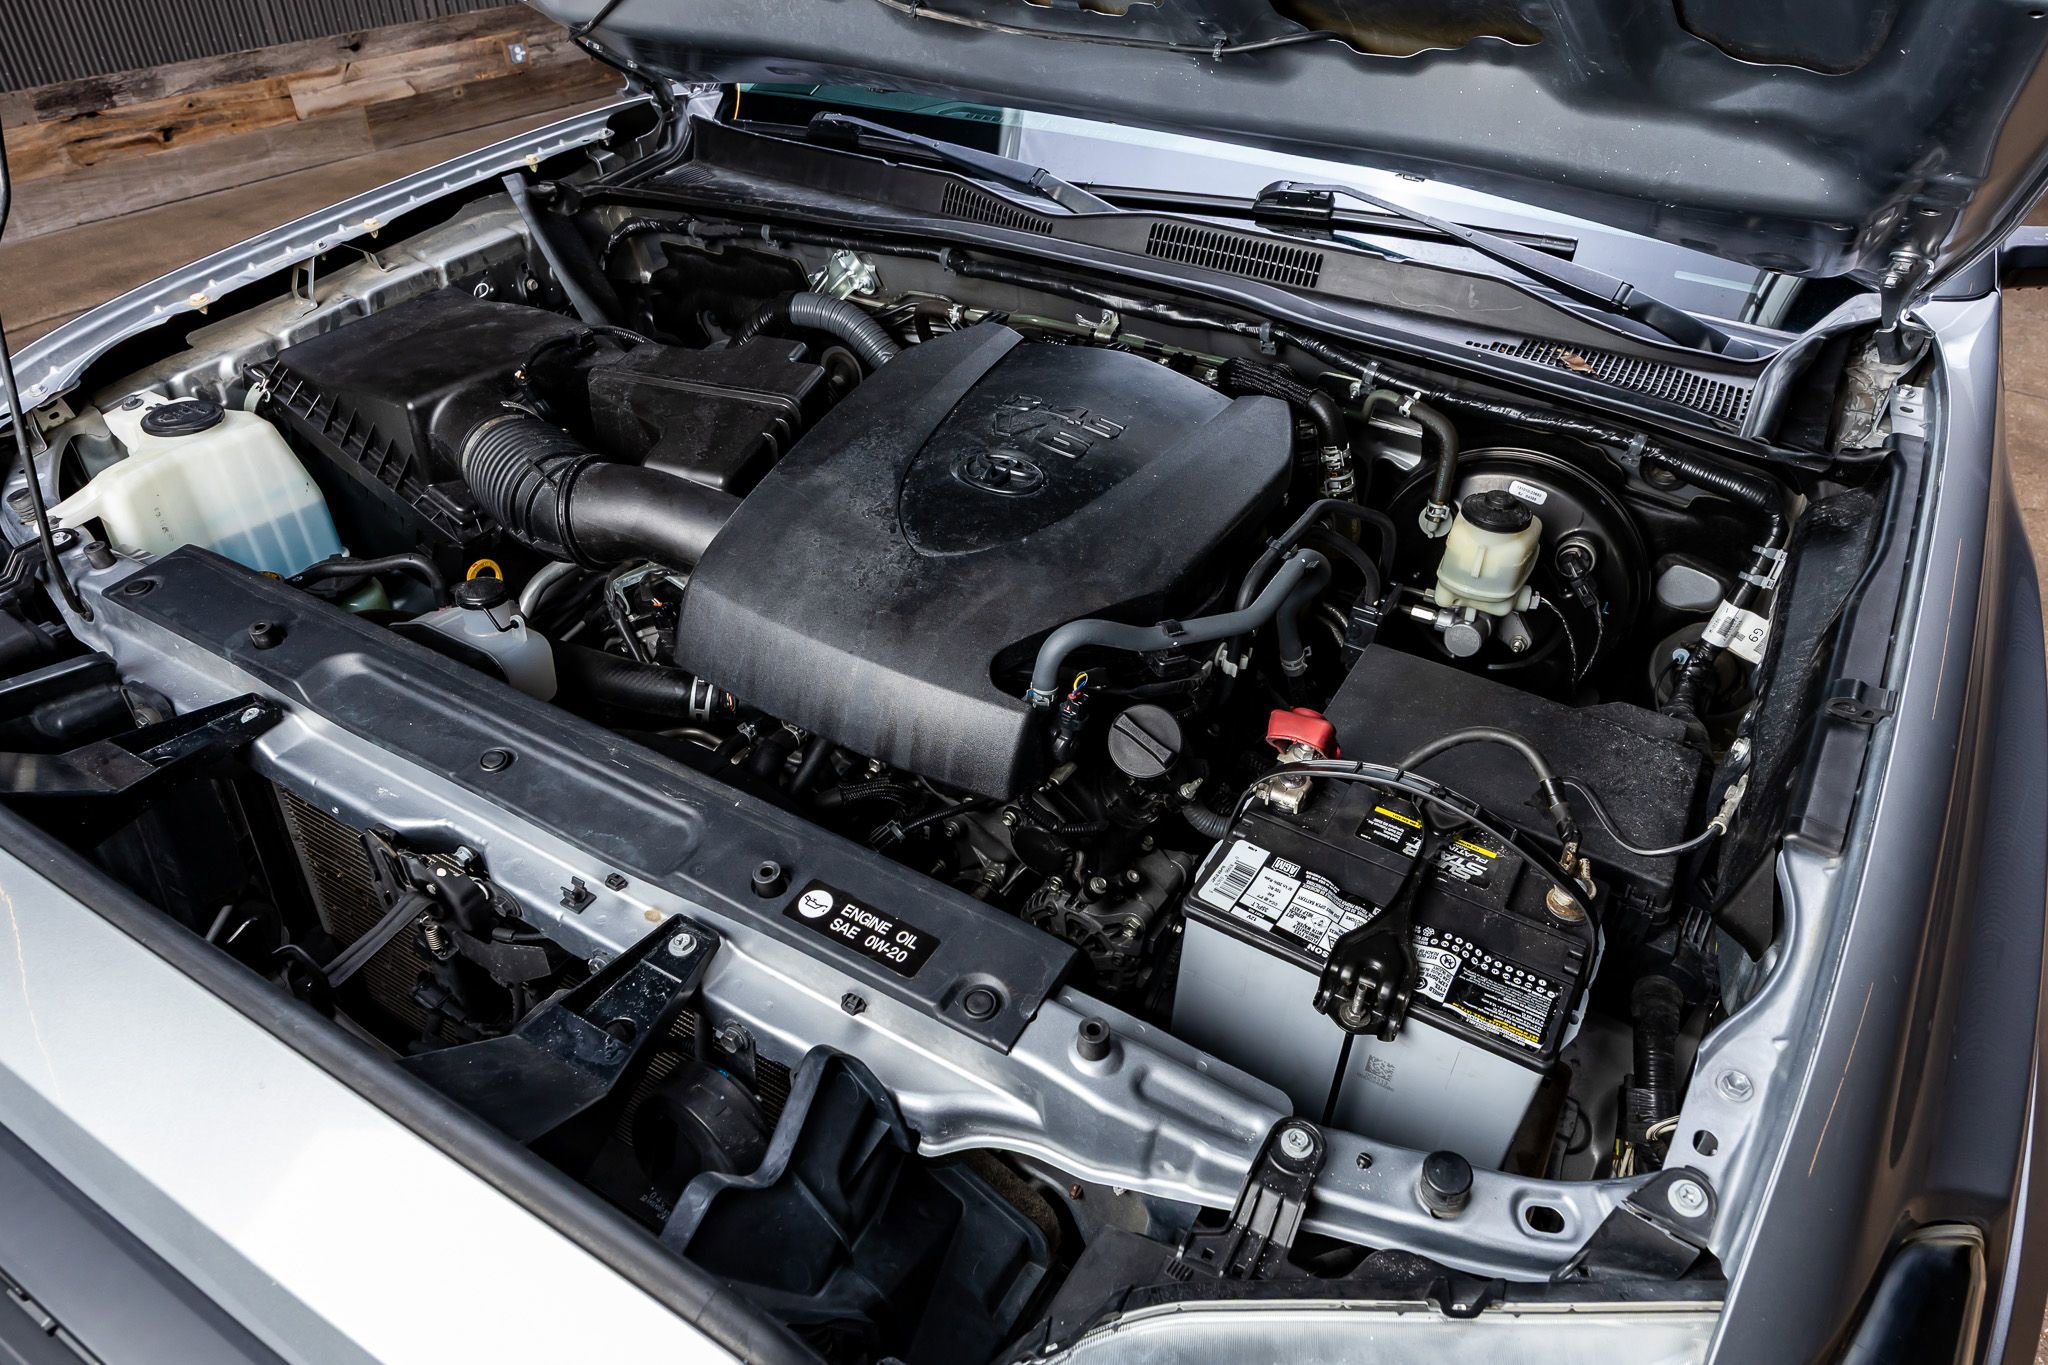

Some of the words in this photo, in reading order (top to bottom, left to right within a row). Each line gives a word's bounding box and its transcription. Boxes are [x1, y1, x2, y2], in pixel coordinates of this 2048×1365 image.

[1274, 858, 1298, 876] AGM
[840, 904, 892, 934] ENGINE
[896, 930, 918, 950] OIL
[830, 918, 861, 939] SAE
[864, 935, 908, 963] 0W-20
[1306, 942, 1330, 959] SON
[1425, 972, 1449, 987] EXPLOSIVE
[1428, 986, 1444, 998] SHIELD
